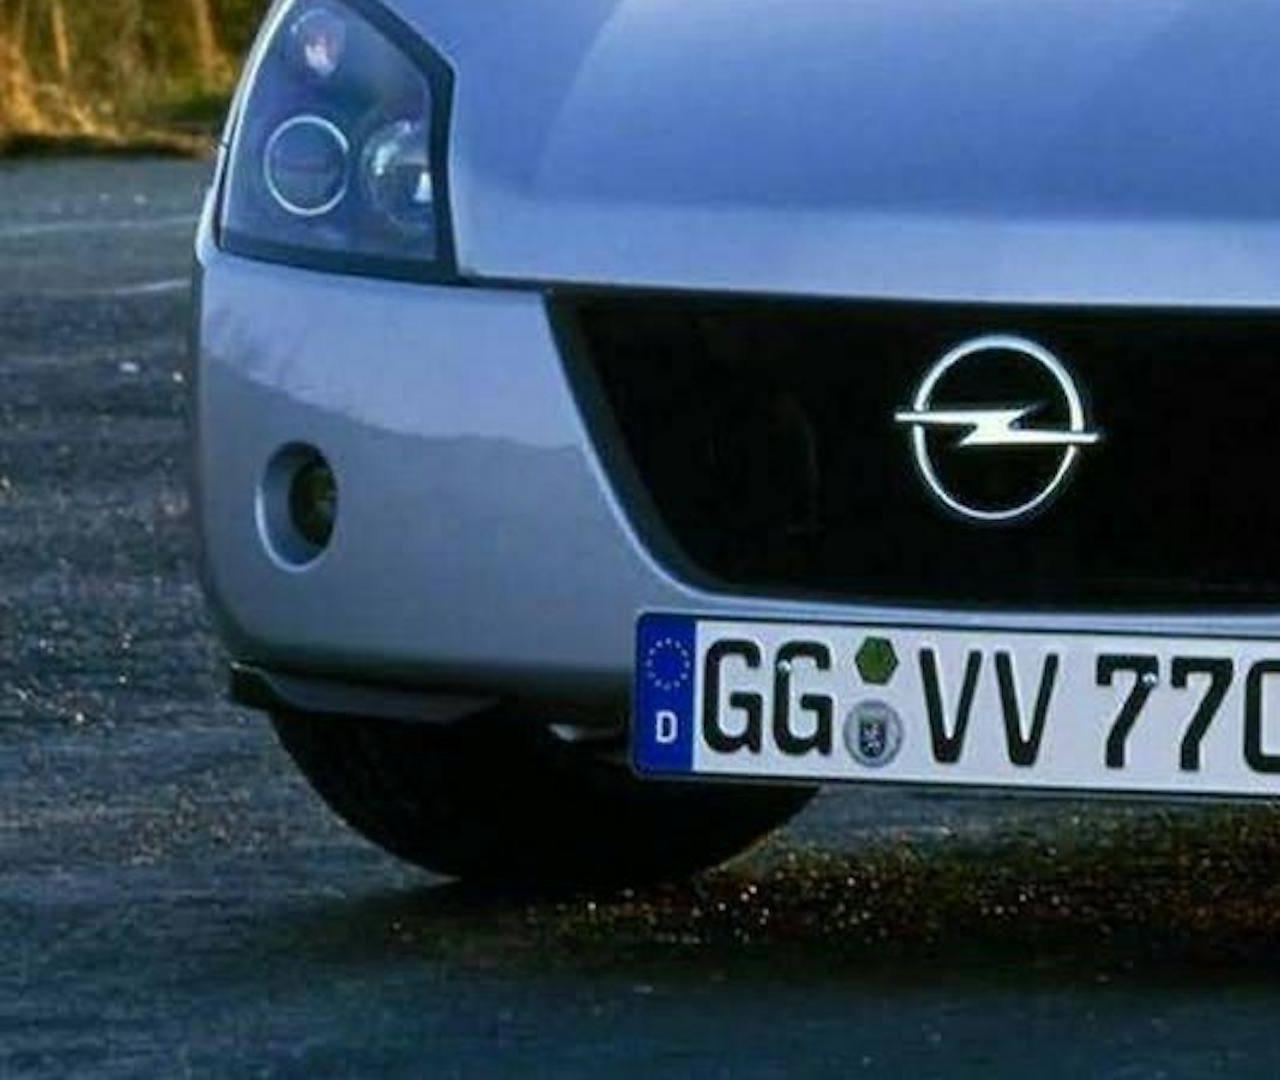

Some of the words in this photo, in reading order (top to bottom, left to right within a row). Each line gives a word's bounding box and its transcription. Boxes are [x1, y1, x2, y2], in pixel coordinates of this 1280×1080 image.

[655, 711, 678, 743] D
[703, 639, 832, 755] GG
[919, 647, 1059, 766] VV
